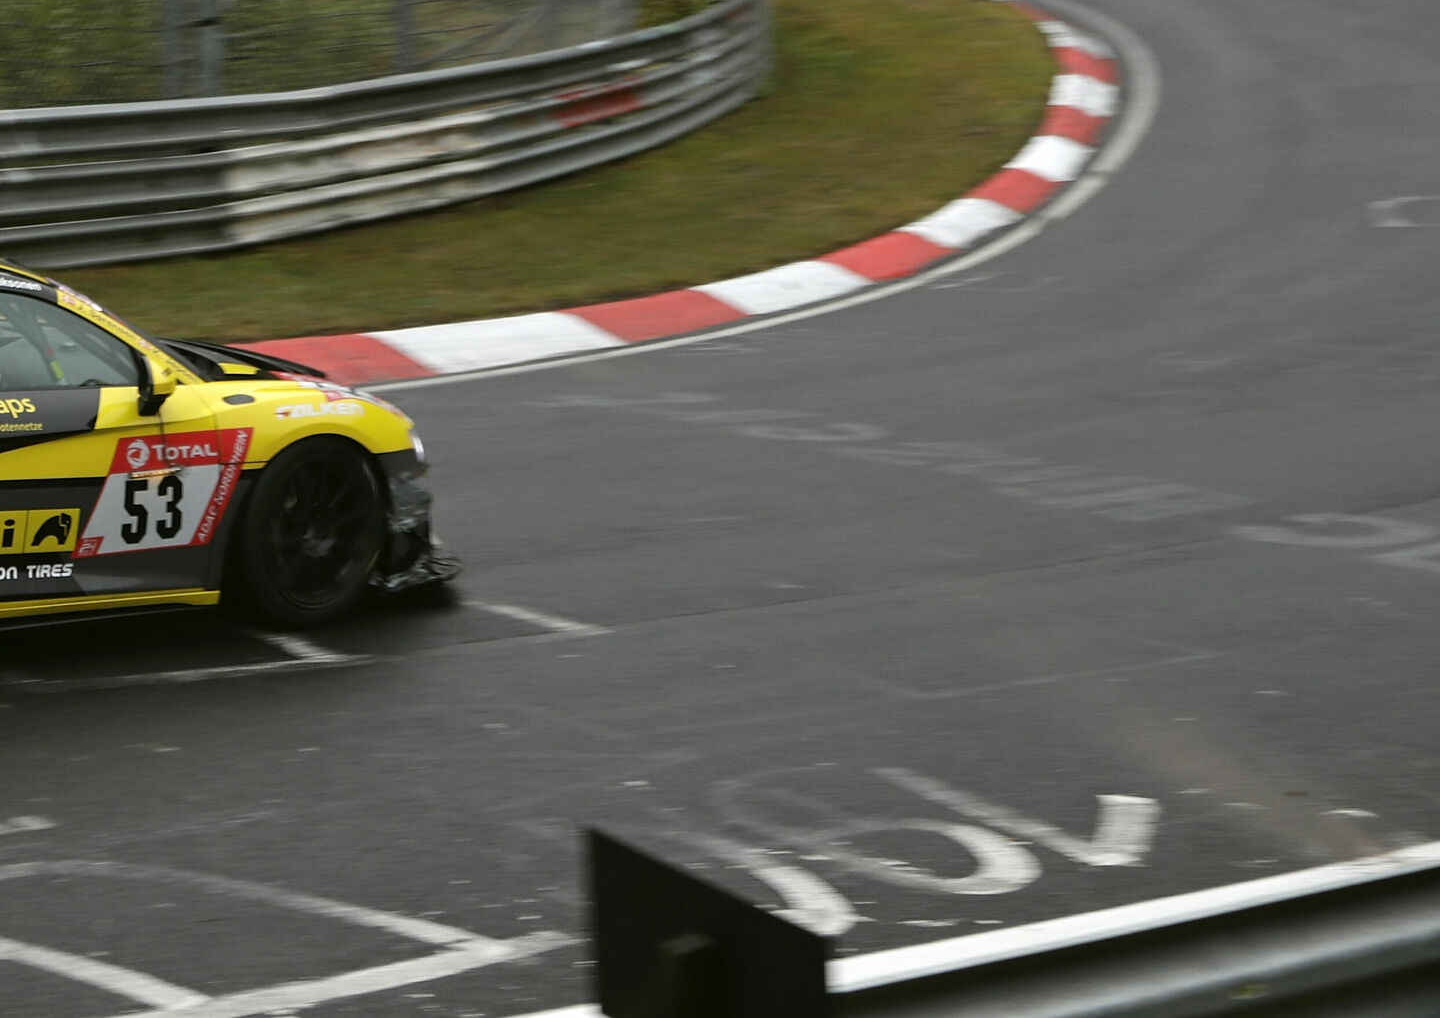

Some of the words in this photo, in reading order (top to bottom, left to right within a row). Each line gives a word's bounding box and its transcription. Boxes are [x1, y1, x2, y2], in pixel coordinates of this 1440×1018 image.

[276, 402, 366, 421] FALKEN
[120, 474, 184, 545] 53
[26, 563, 75, 579] TIRES
